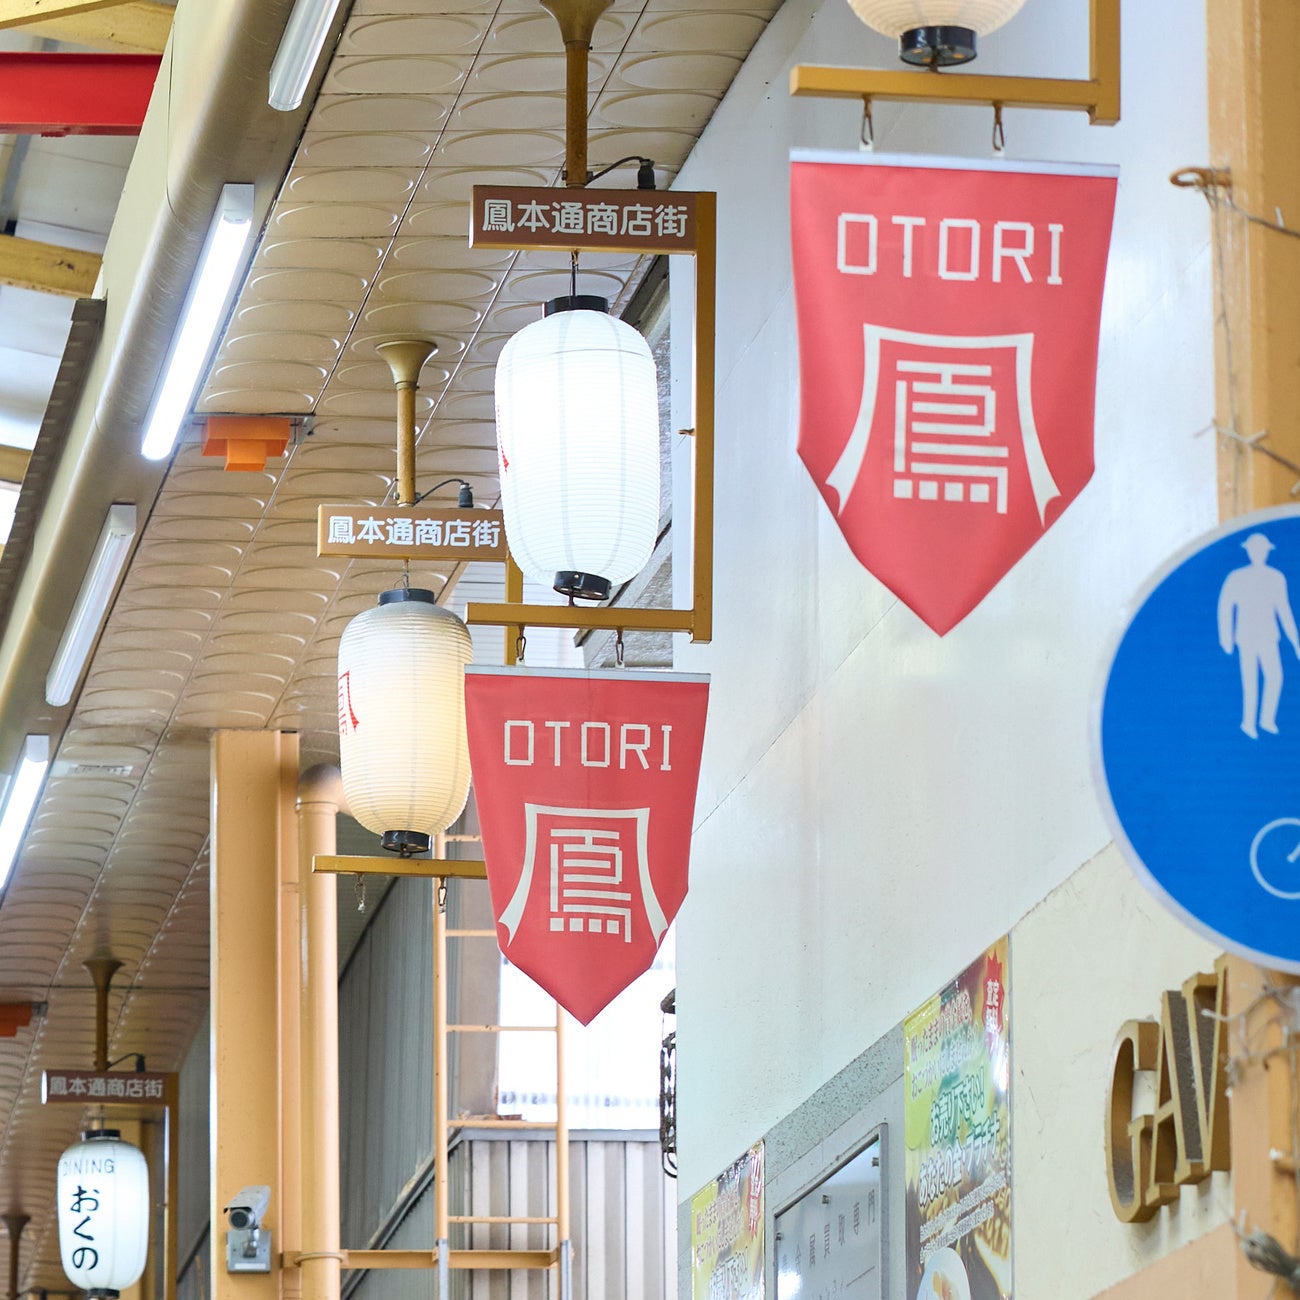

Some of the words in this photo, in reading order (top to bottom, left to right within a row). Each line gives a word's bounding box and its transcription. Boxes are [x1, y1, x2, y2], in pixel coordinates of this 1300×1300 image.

[482, 198, 688, 238] 鳳本通商店街
[836, 212, 1064, 285] OTORI
[327, 515, 500, 547] 鳳本通商店街
[504, 719, 673, 772] OTORI
[49, 1076, 163, 1099] 鳳本通商店街
[71, 1184, 99, 1271] おくの
